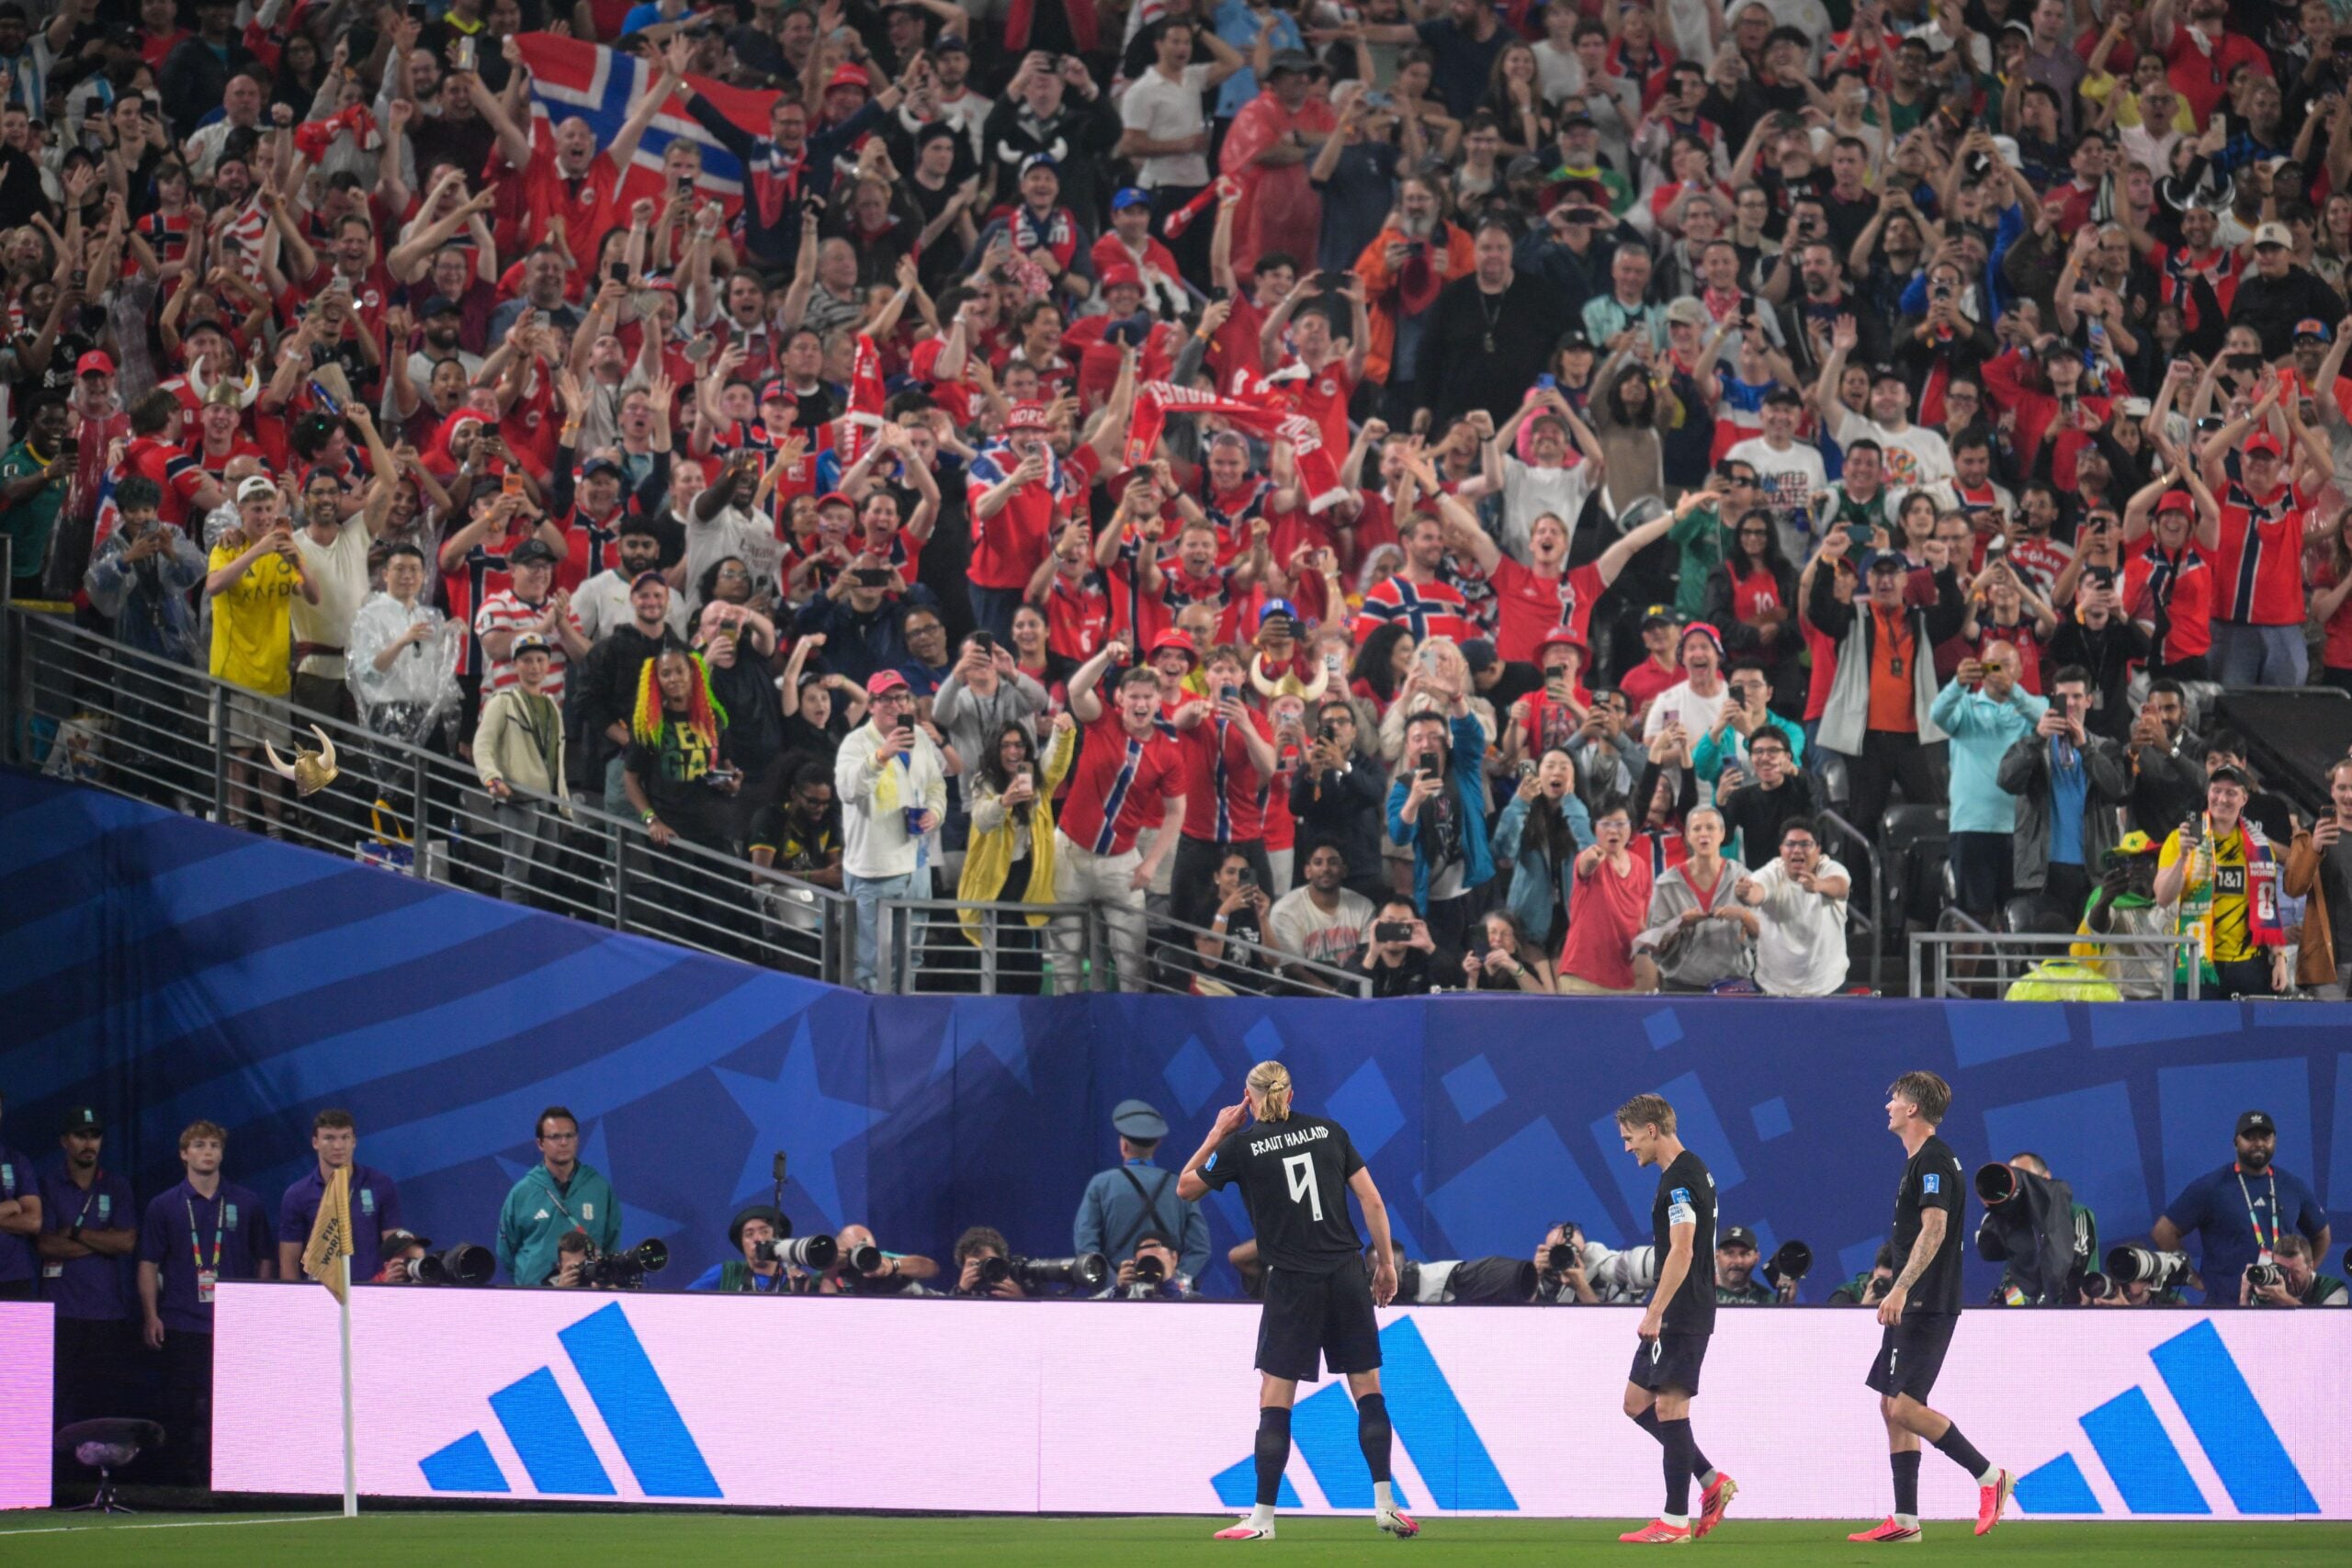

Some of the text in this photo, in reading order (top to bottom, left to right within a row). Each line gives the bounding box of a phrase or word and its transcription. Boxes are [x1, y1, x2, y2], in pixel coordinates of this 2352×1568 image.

[1011, 409, 1045, 424] NORG
[2216, 871, 2243, 888] 1&1
[1250, 1125, 1329, 1156] BRAUT HAALAND
[1282, 1152, 1323, 1222] 9
[322, 1217, 339, 1241] FIFA
[321, 1235, 341, 1266] WORL
